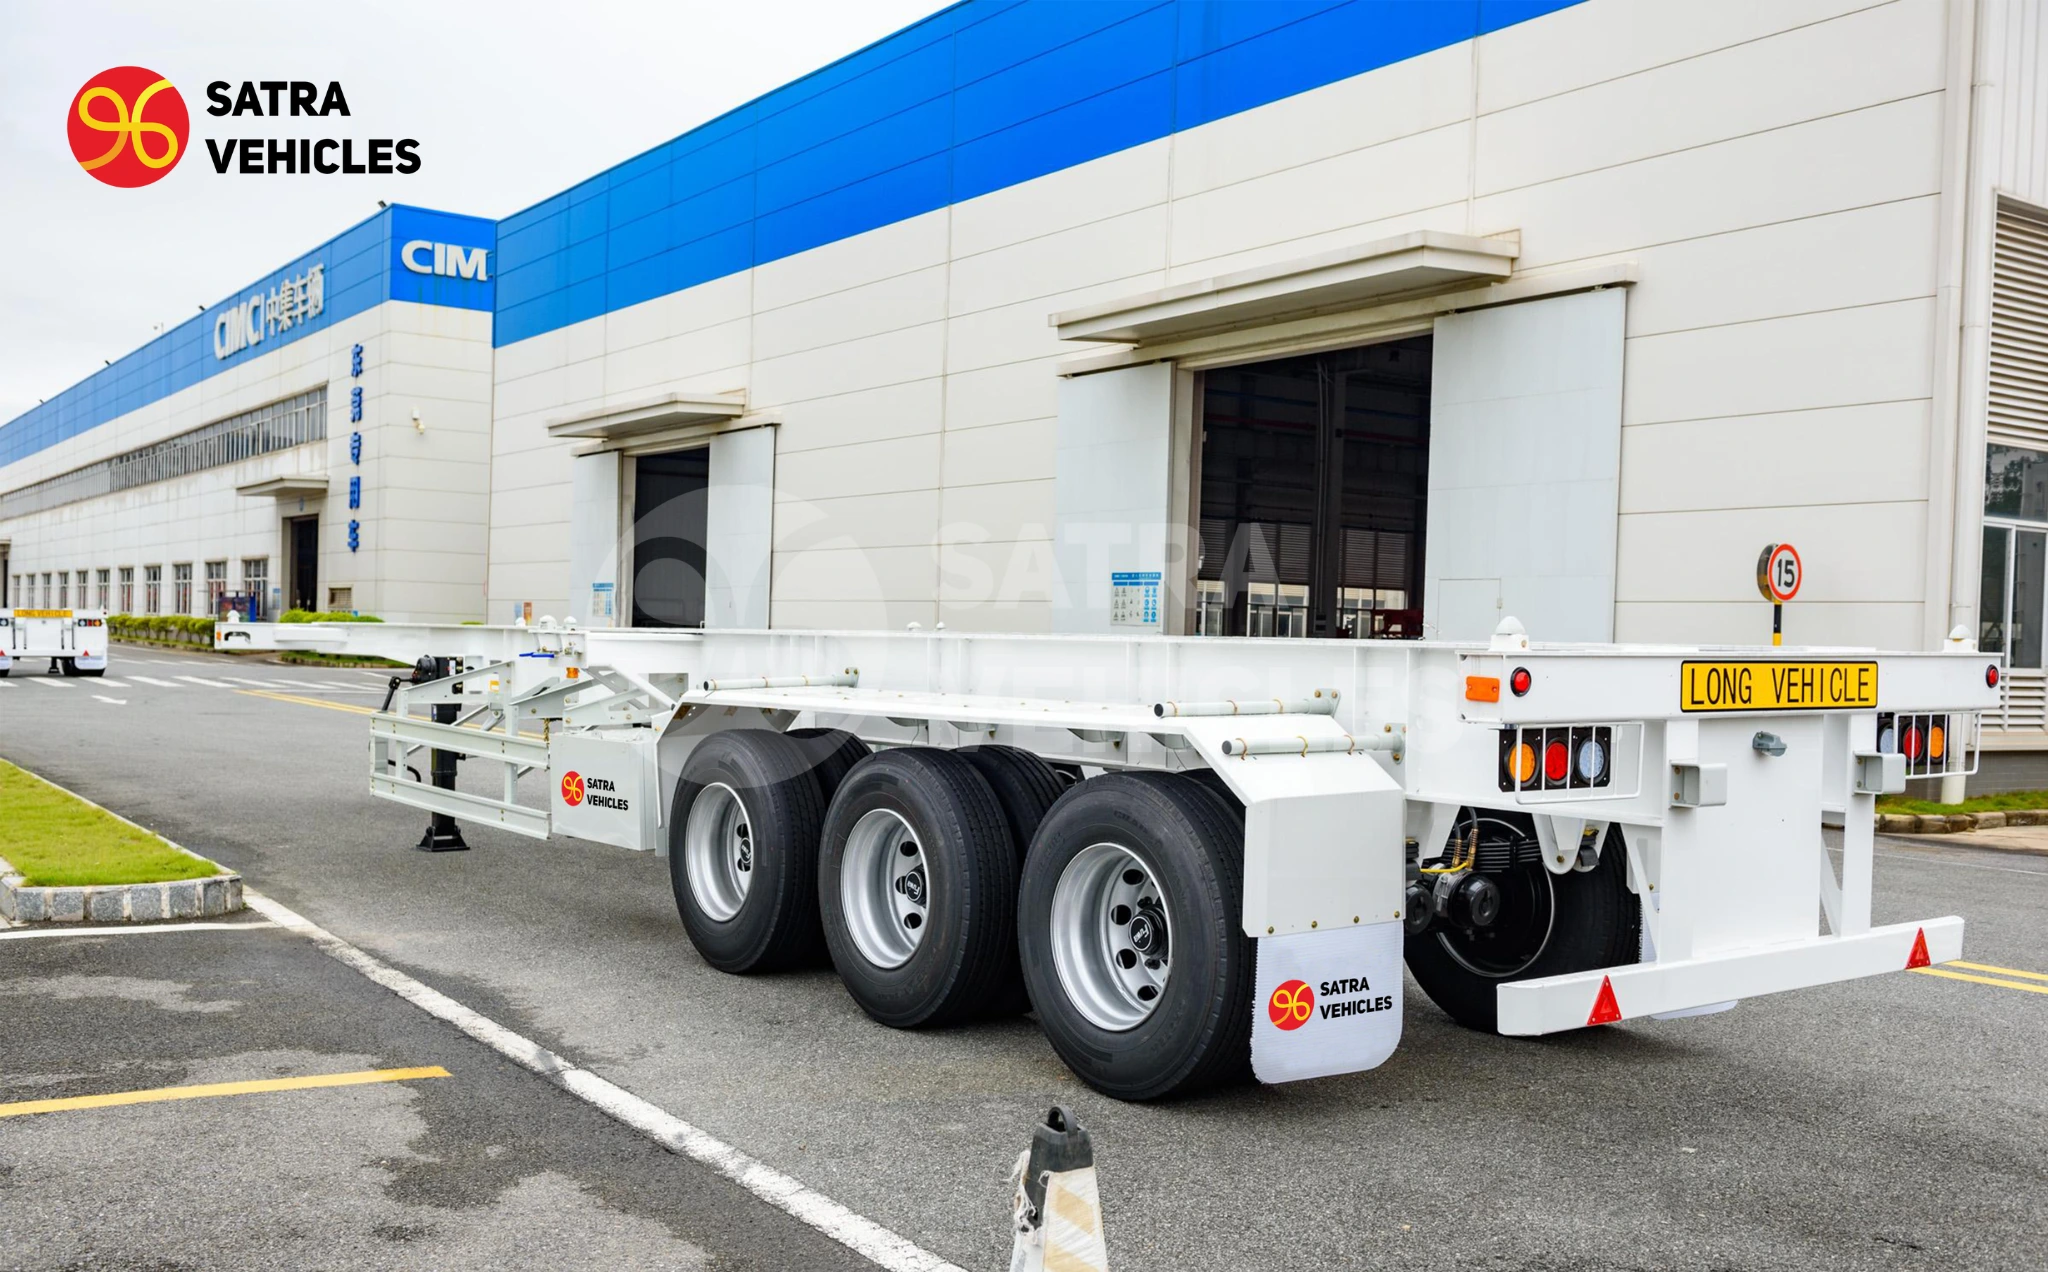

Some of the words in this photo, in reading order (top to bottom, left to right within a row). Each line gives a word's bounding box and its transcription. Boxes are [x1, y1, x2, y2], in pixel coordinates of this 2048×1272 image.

[401, 239, 494, 282] CIM
[1777, 558, 1795, 588] 15
[1690, 667, 1752, 706] LONG
[1771, 667, 1870, 704] VEHICLE
[586, 777, 615, 792] SATRA
[586, 794, 629, 811] VEHICLES
[1320, 977, 1370, 996] SATRA
[1320, 996, 1393, 1019] VEHICLES
